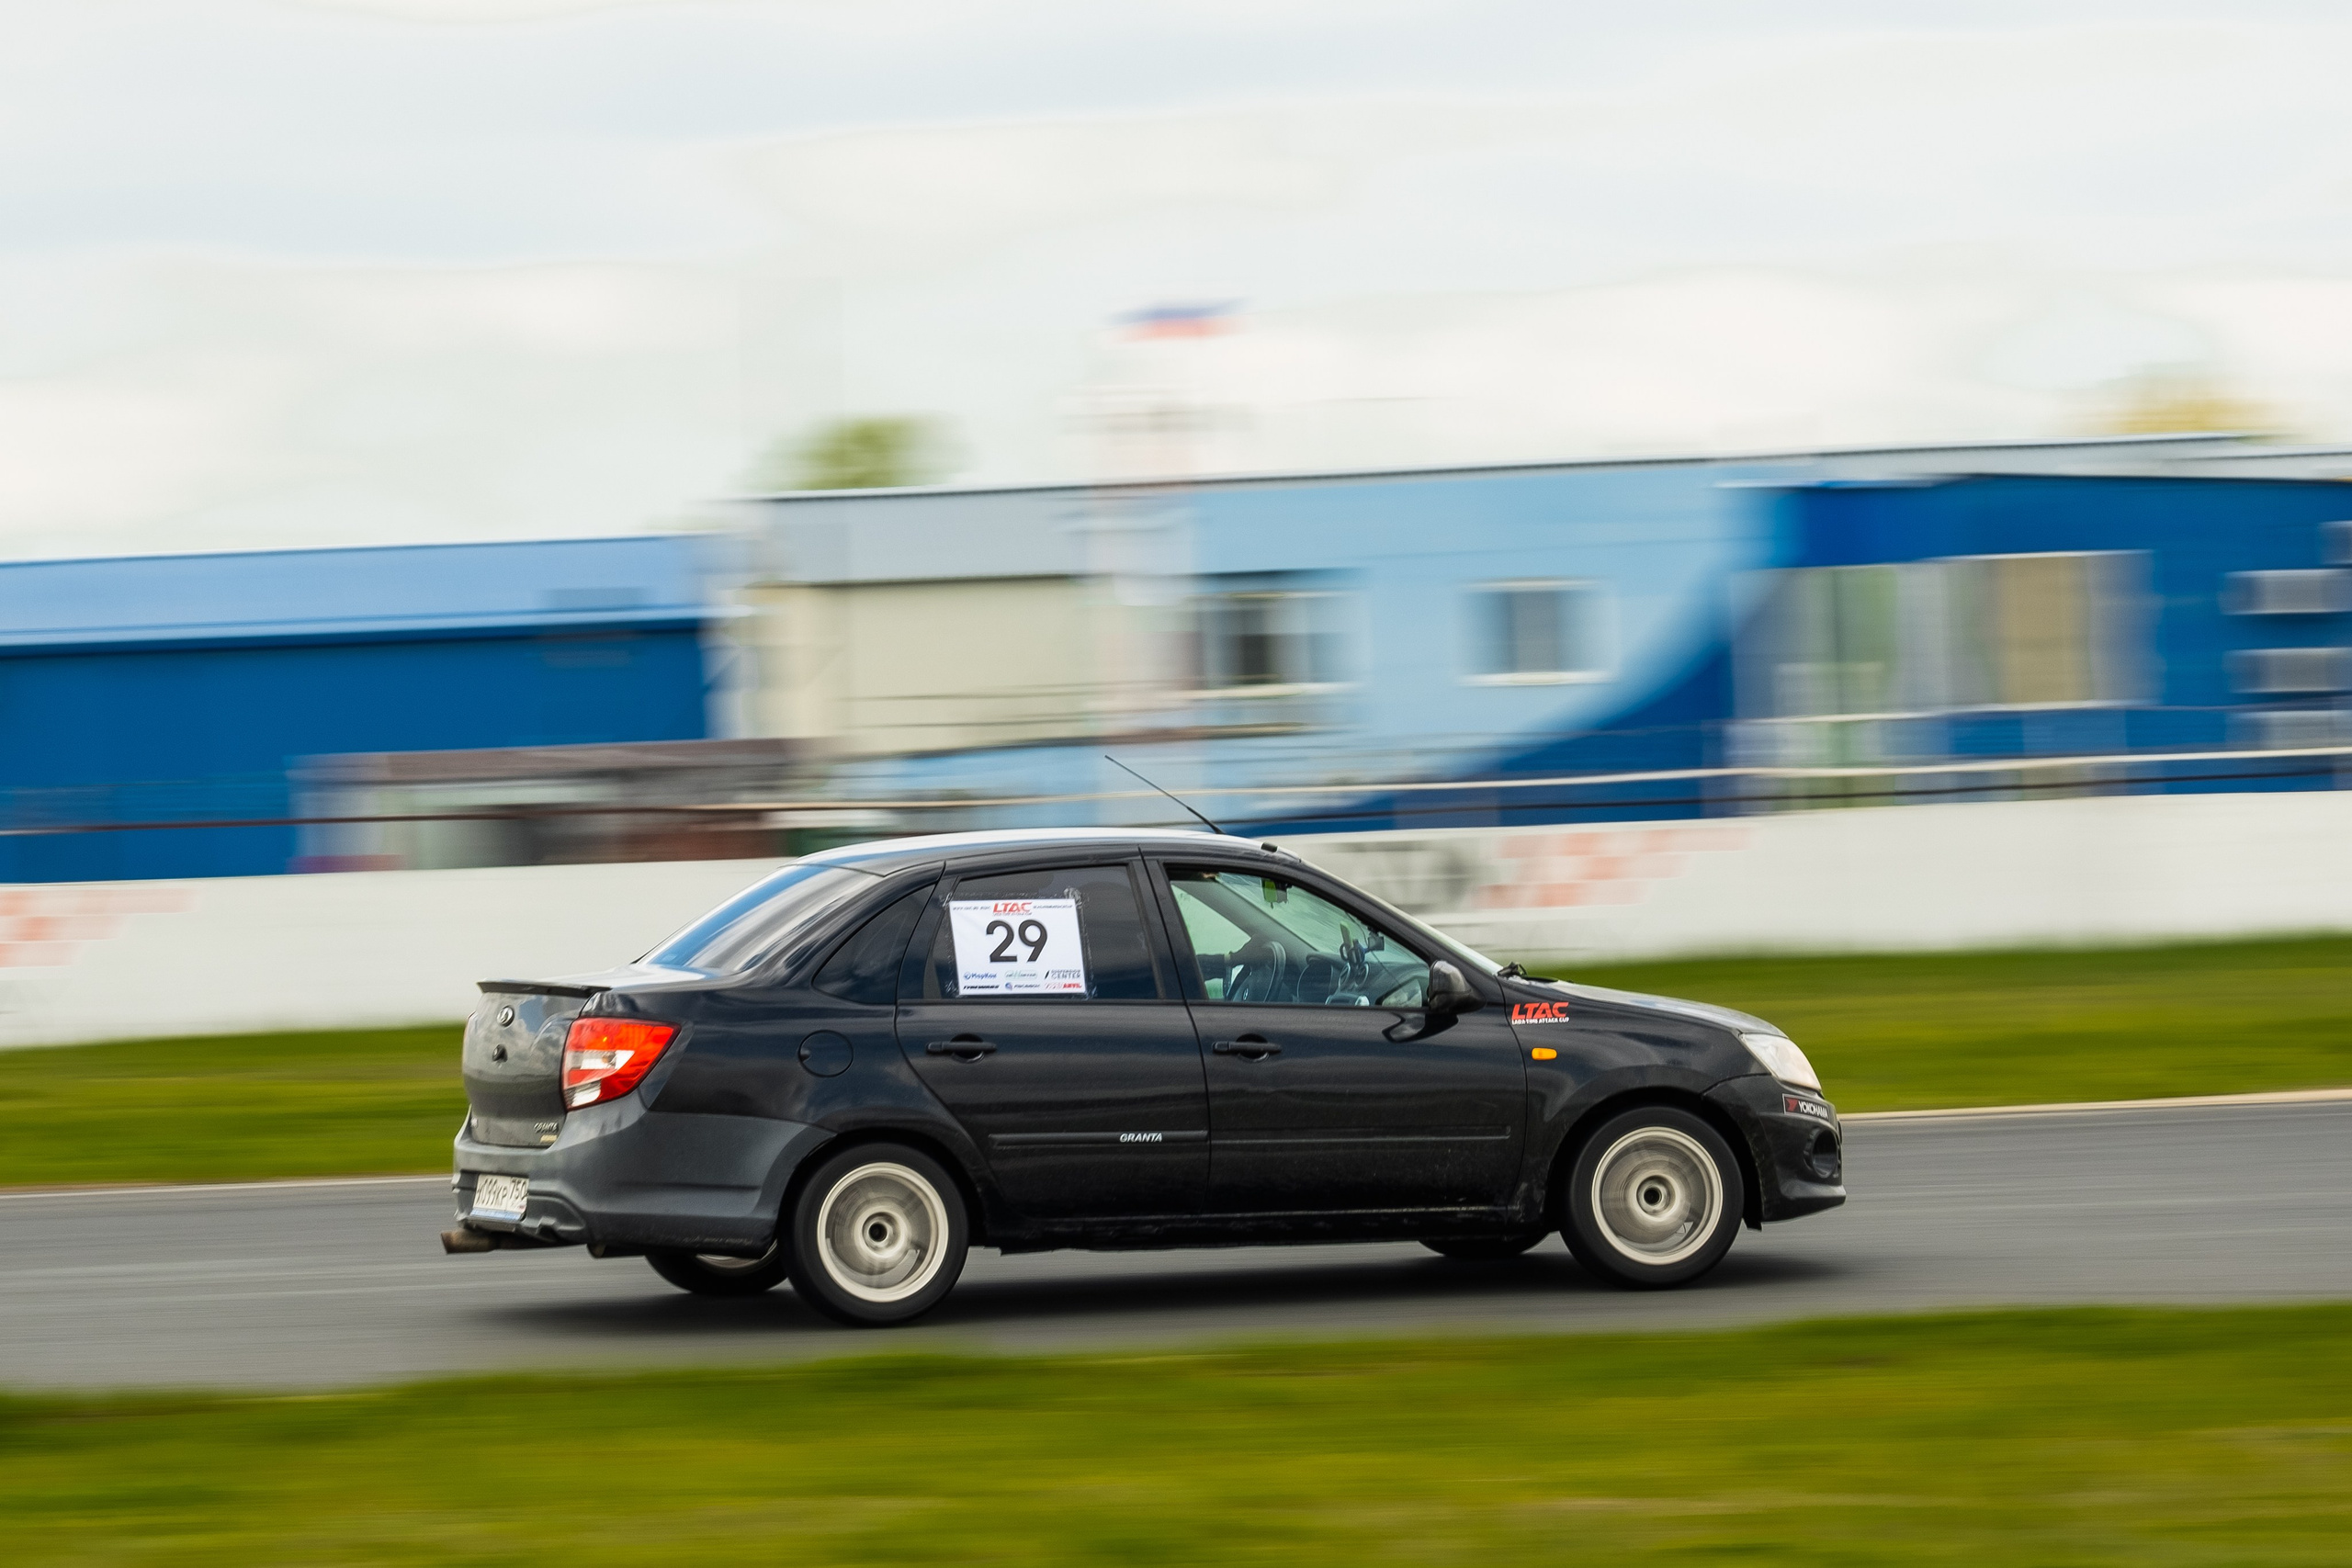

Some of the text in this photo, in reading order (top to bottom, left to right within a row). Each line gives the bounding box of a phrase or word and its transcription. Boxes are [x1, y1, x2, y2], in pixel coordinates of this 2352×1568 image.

[993, 901, 1033, 913] LTAC
[986, 919, 1048, 963] 29
[1511, 1001, 1569, 1020] LTAC
[1798, 1100, 1829, 1119] YOKOHAMA
[1119, 1132, 1163, 1143] GRANTA
